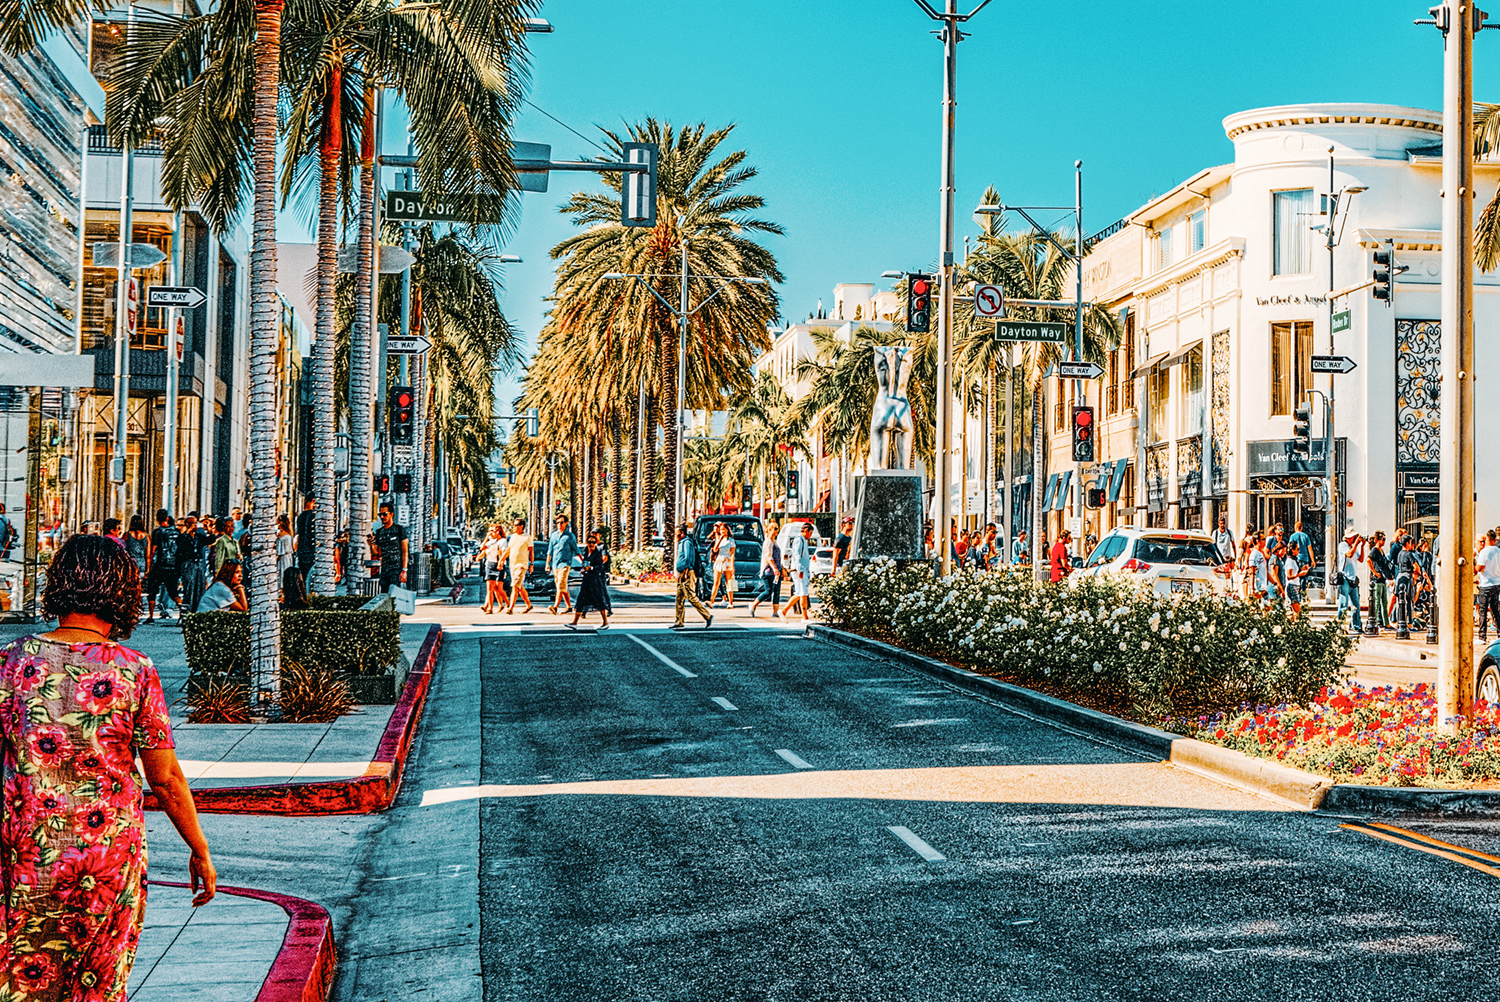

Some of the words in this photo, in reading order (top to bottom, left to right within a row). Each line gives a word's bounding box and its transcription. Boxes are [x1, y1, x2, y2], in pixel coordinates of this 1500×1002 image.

[152, 293, 168, 301] ONE
[171, 293, 188, 301] WAY
[1001, 326, 1037, 339] Dayton
[1040, 327, 1061, 340] Way
[401, 341, 415, 349] WAY
[1258, 453, 1270, 462] Van
[1271, 452, 1290, 462] Cleef
[382, 478, 388, 491] 6
[1409, 476, 1420, 484] Van
[1421, 476, 1438, 484] Cleef
[1100, 492, 1105, 504] 6
